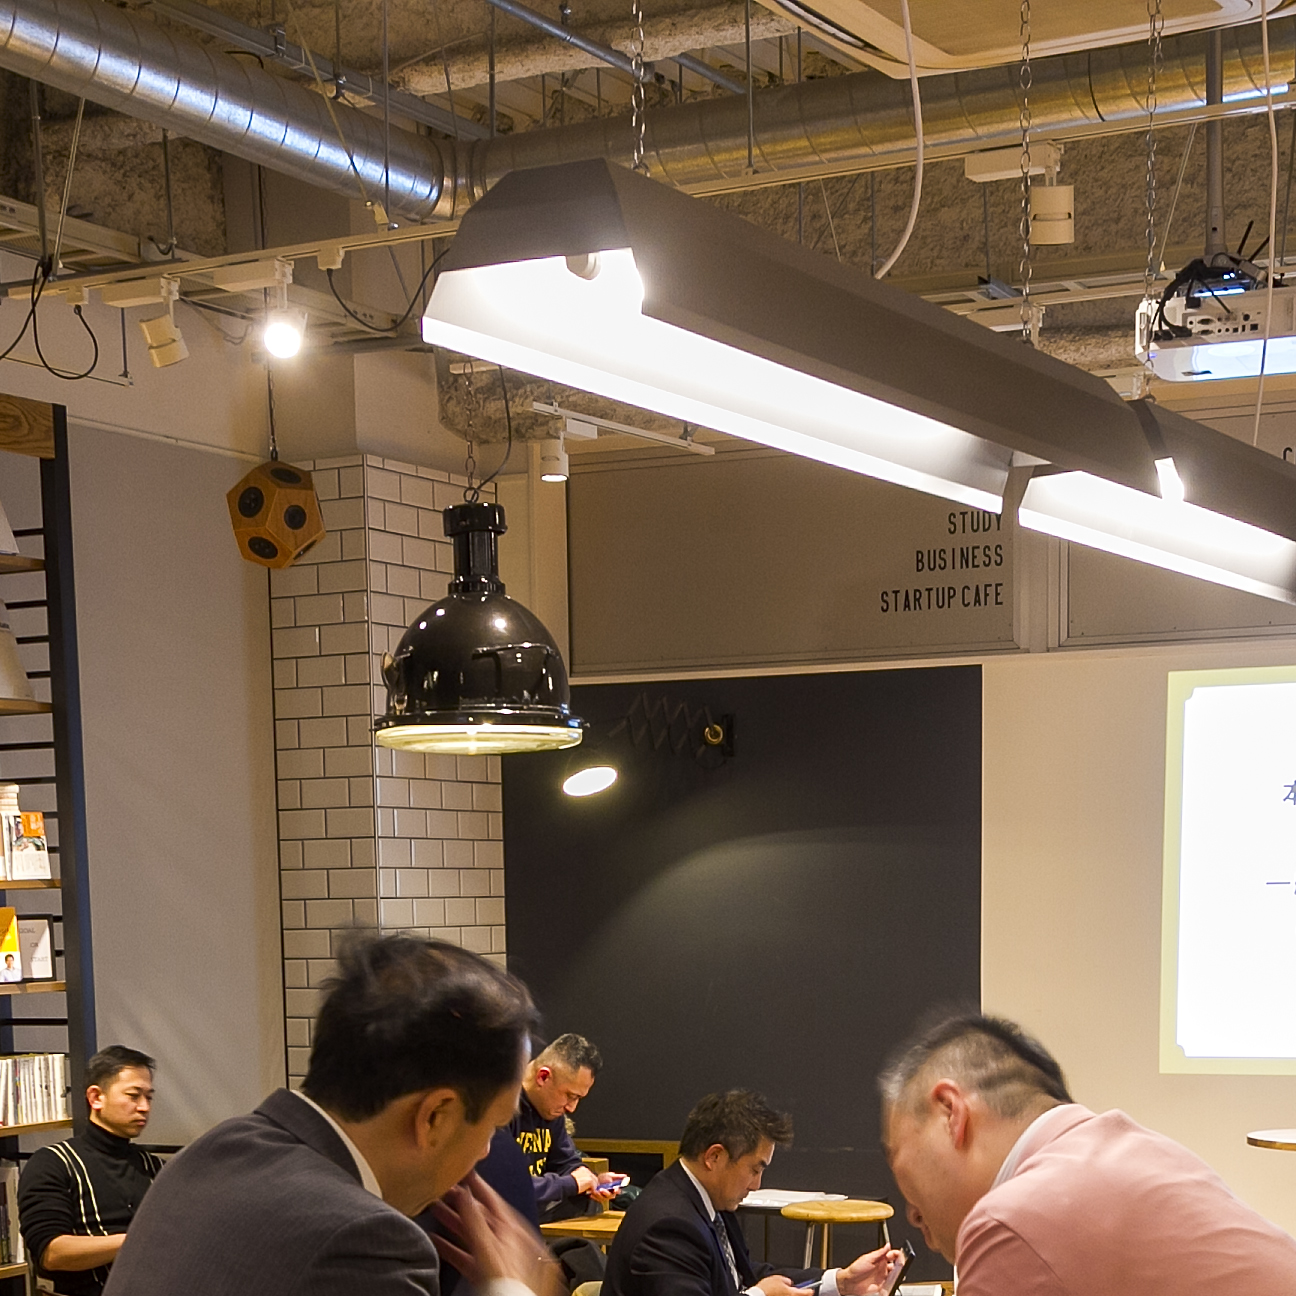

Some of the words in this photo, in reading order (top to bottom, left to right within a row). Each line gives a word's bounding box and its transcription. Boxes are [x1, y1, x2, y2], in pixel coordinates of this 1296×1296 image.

[948, 511, 1003, 534] STUDY
[916, 545, 1003, 571] BUSINESS
[880, 587, 957, 613] STARTUP
[962, 583, 1003, 608] CAFE
